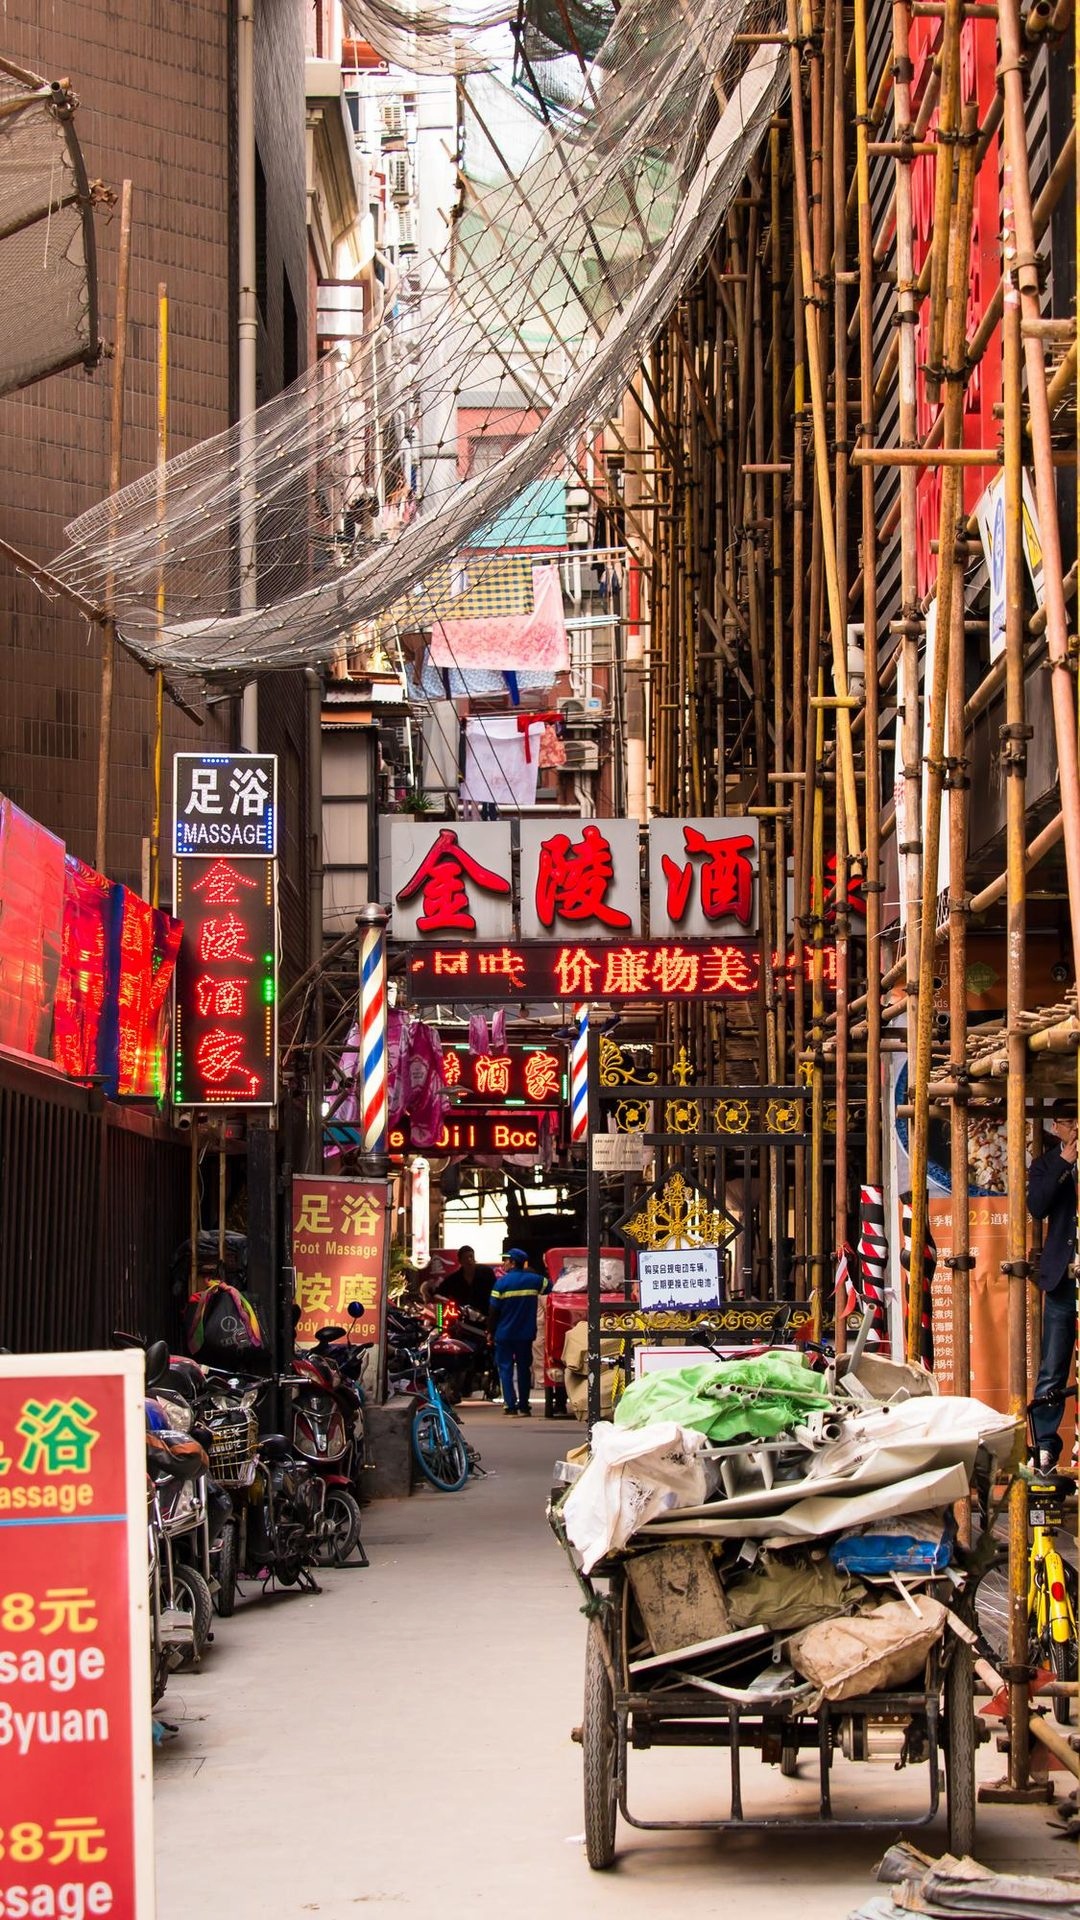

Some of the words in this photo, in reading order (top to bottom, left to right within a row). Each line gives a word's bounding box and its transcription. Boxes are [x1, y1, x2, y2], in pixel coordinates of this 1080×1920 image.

[184, 768, 269, 816] 足浴
[184, 823, 267, 844] MASSAGE
[192, 859, 258, 1082] 金陵酒家
[294, 1194, 381, 1236] 足浴
[294, 1240, 320, 1255] Foot
[325, 1241, 378, 1259] Massage
[296, 1272, 378, 1314] 按摩
[295, 1319, 319, 1336] ody
[0, 1396, 100, 1475] 浴
[0, 1817, 108, 1865] 8元
[0, 1881, 114, 1920] sage
